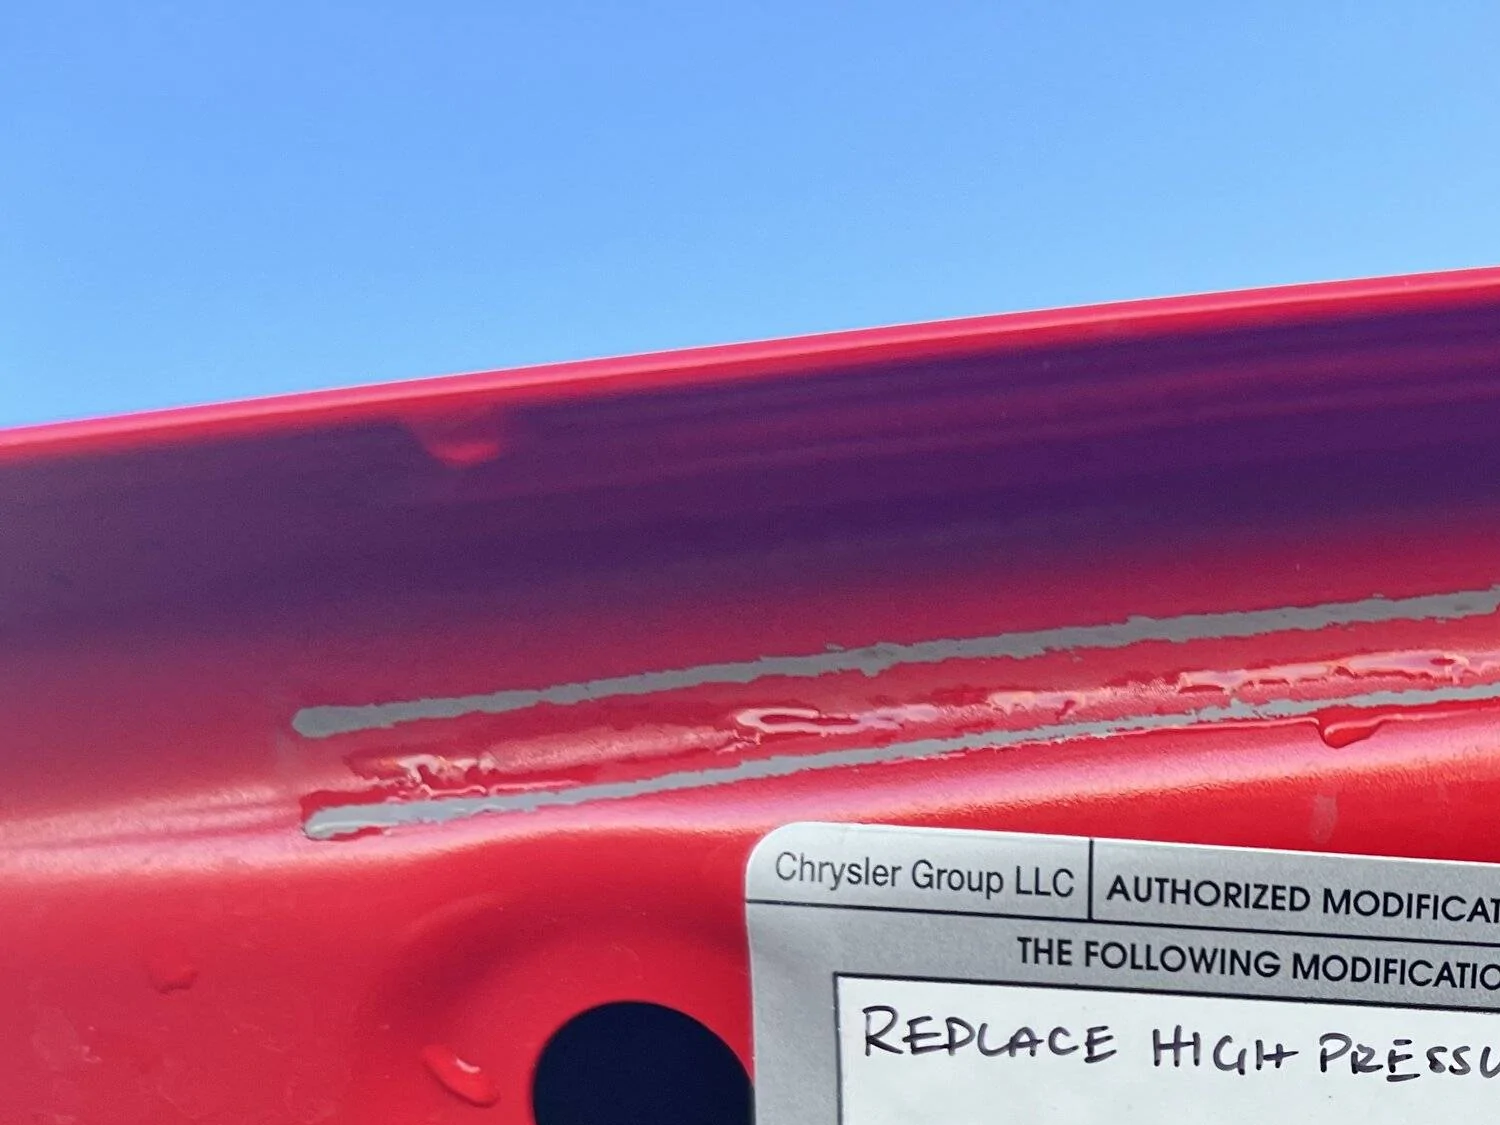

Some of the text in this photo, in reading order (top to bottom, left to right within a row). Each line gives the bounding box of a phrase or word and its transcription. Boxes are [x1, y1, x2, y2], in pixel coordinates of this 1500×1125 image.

[776, 852, 1074, 899] Chrysler Group LLC
[1107, 875, 1310, 911] AUTHORIZED
[1017, 937, 1072, 966] THE
[1085, 941, 1281, 978] FOLLOWING
[1153, 1025, 1299, 1075] HIGH
